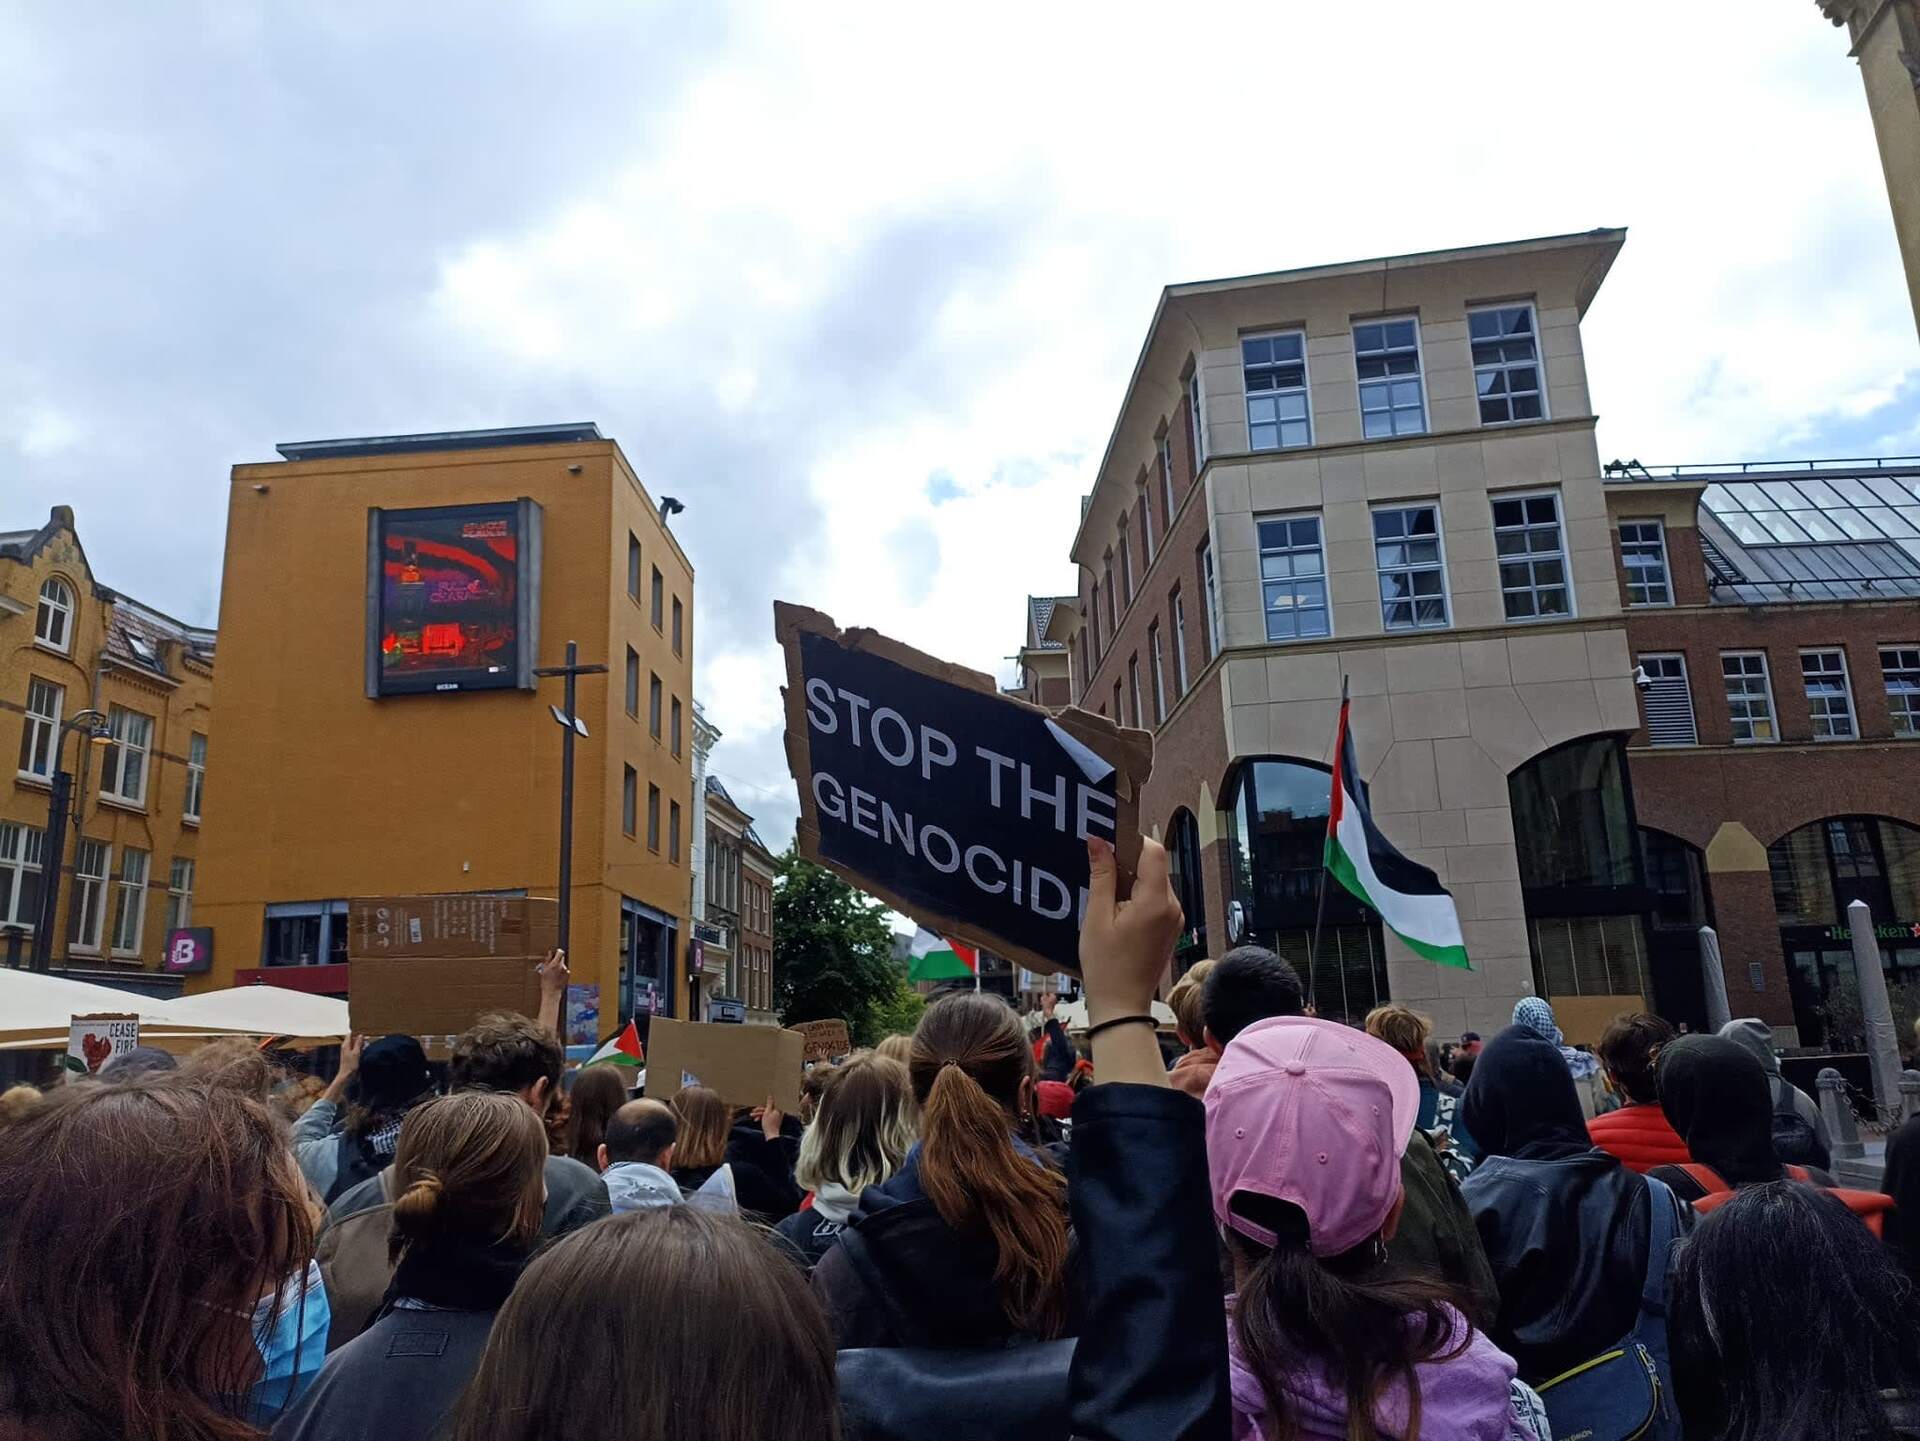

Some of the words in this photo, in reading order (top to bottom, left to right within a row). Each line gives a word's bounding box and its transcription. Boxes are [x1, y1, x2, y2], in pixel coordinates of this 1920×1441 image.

[806, 677, 957, 780] STOP
[976, 746, 1117, 852] THE
[1831, 924, 1909, 940] Heken
[109, 1022, 136, 1038] CEASE
